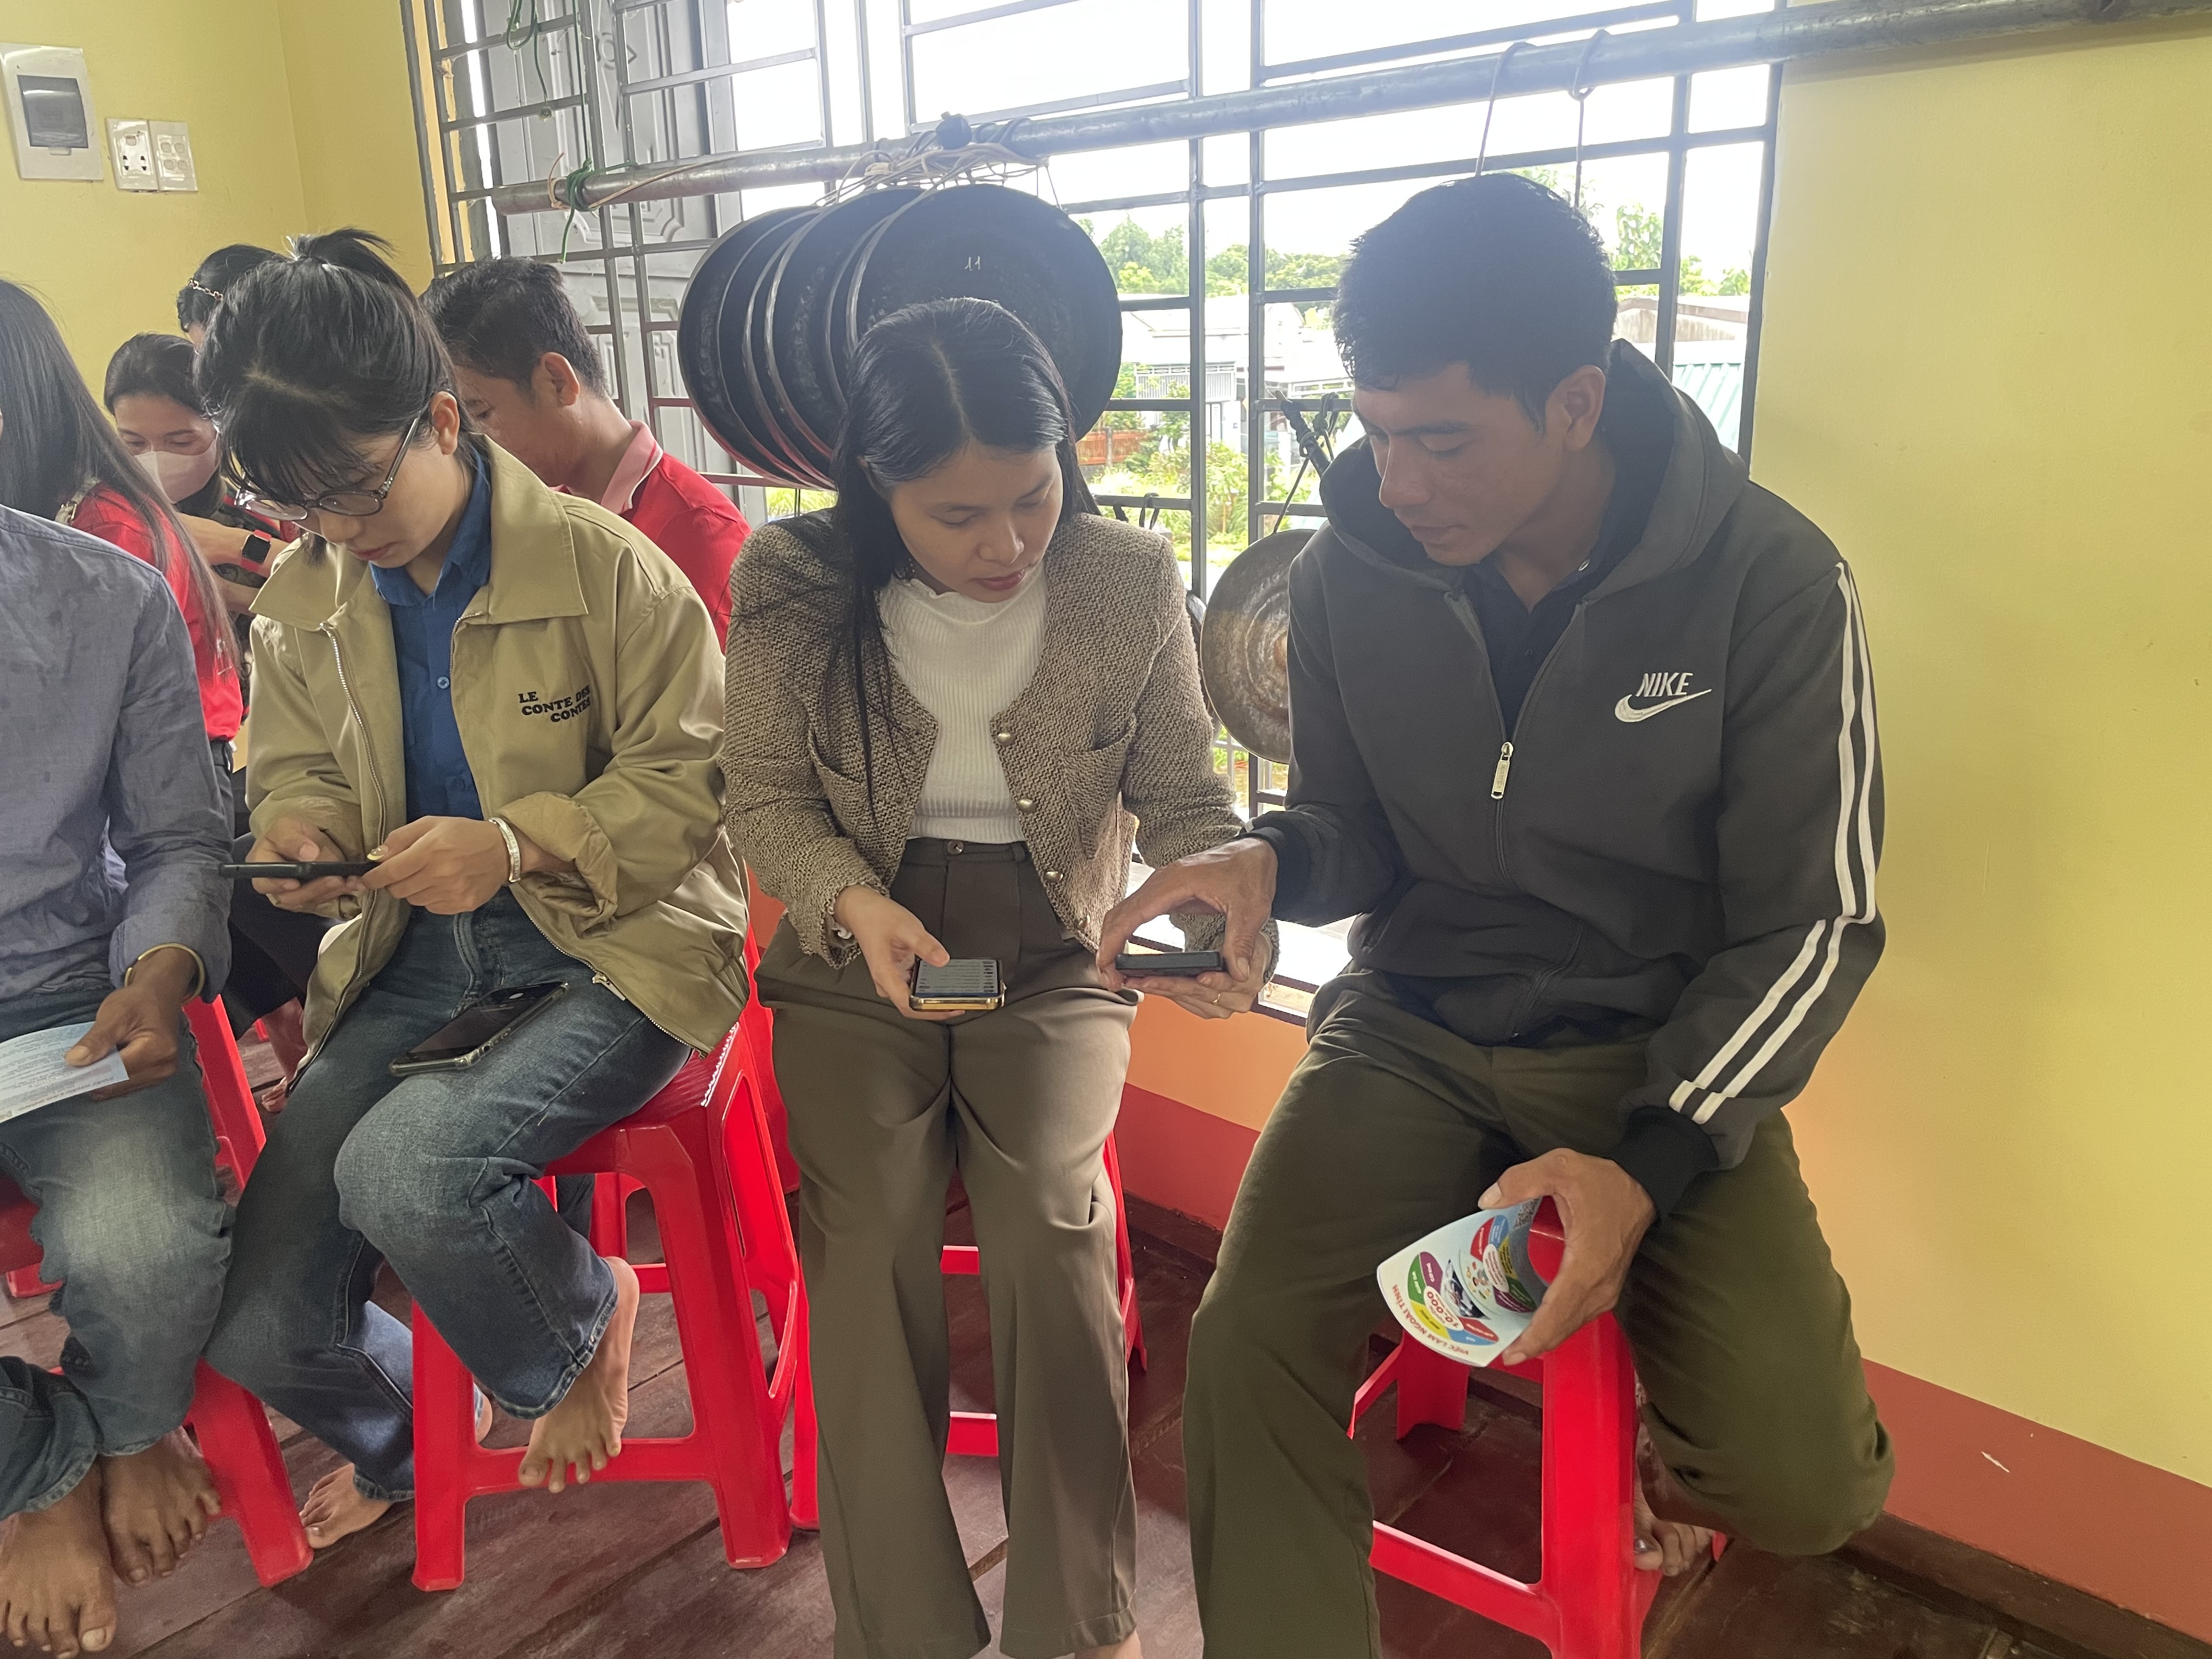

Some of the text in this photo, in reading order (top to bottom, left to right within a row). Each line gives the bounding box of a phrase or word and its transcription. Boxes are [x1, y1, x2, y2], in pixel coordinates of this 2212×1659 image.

[1635, 672, 1694, 697] NIKE
[518, 691, 538, 703] LE
[522, 696, 573, 715] CONTE
